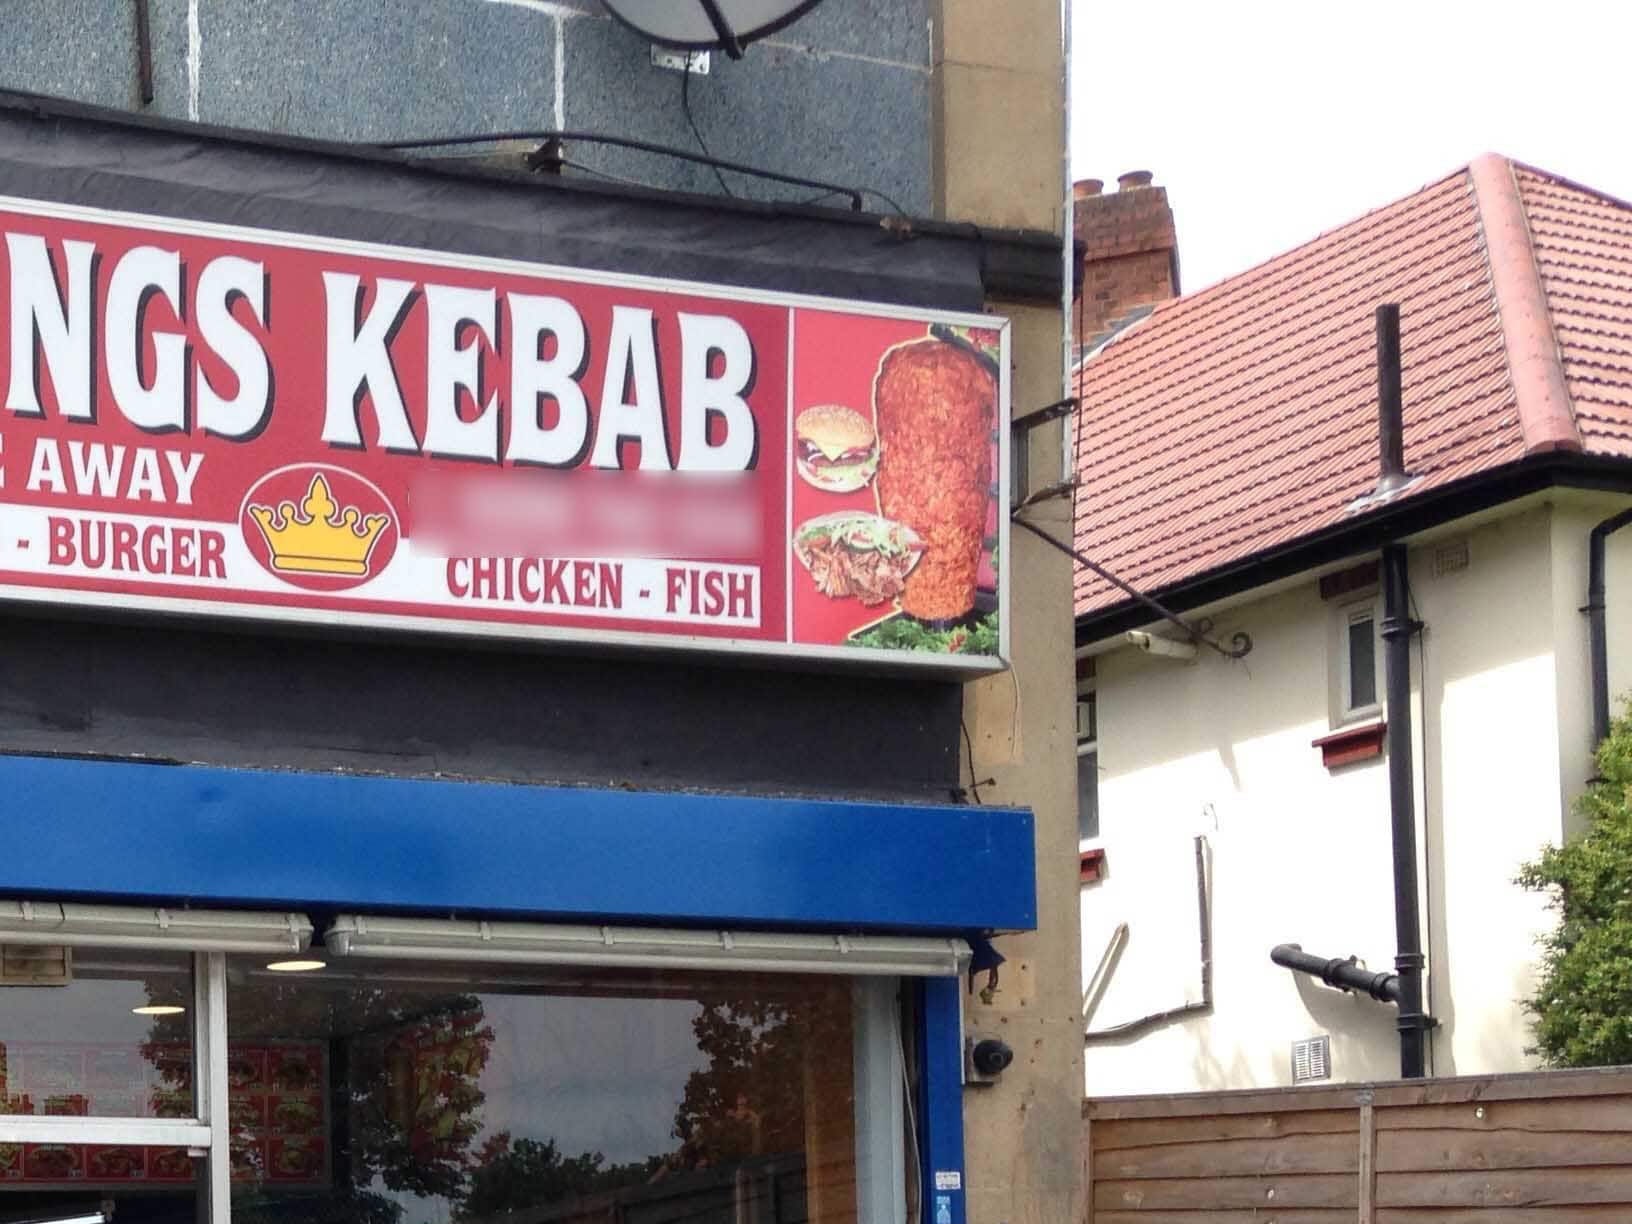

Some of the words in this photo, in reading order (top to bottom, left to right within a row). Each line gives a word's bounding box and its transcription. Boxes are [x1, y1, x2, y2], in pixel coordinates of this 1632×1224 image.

[321, 270, 756, 472] KEBAB
[26, 441, 205, 505] AWAY
[48, 515, 228, 580] BURGER
[446, 557, 624, 610] CHICKEN
[665, 567, 755, 619] FISH
